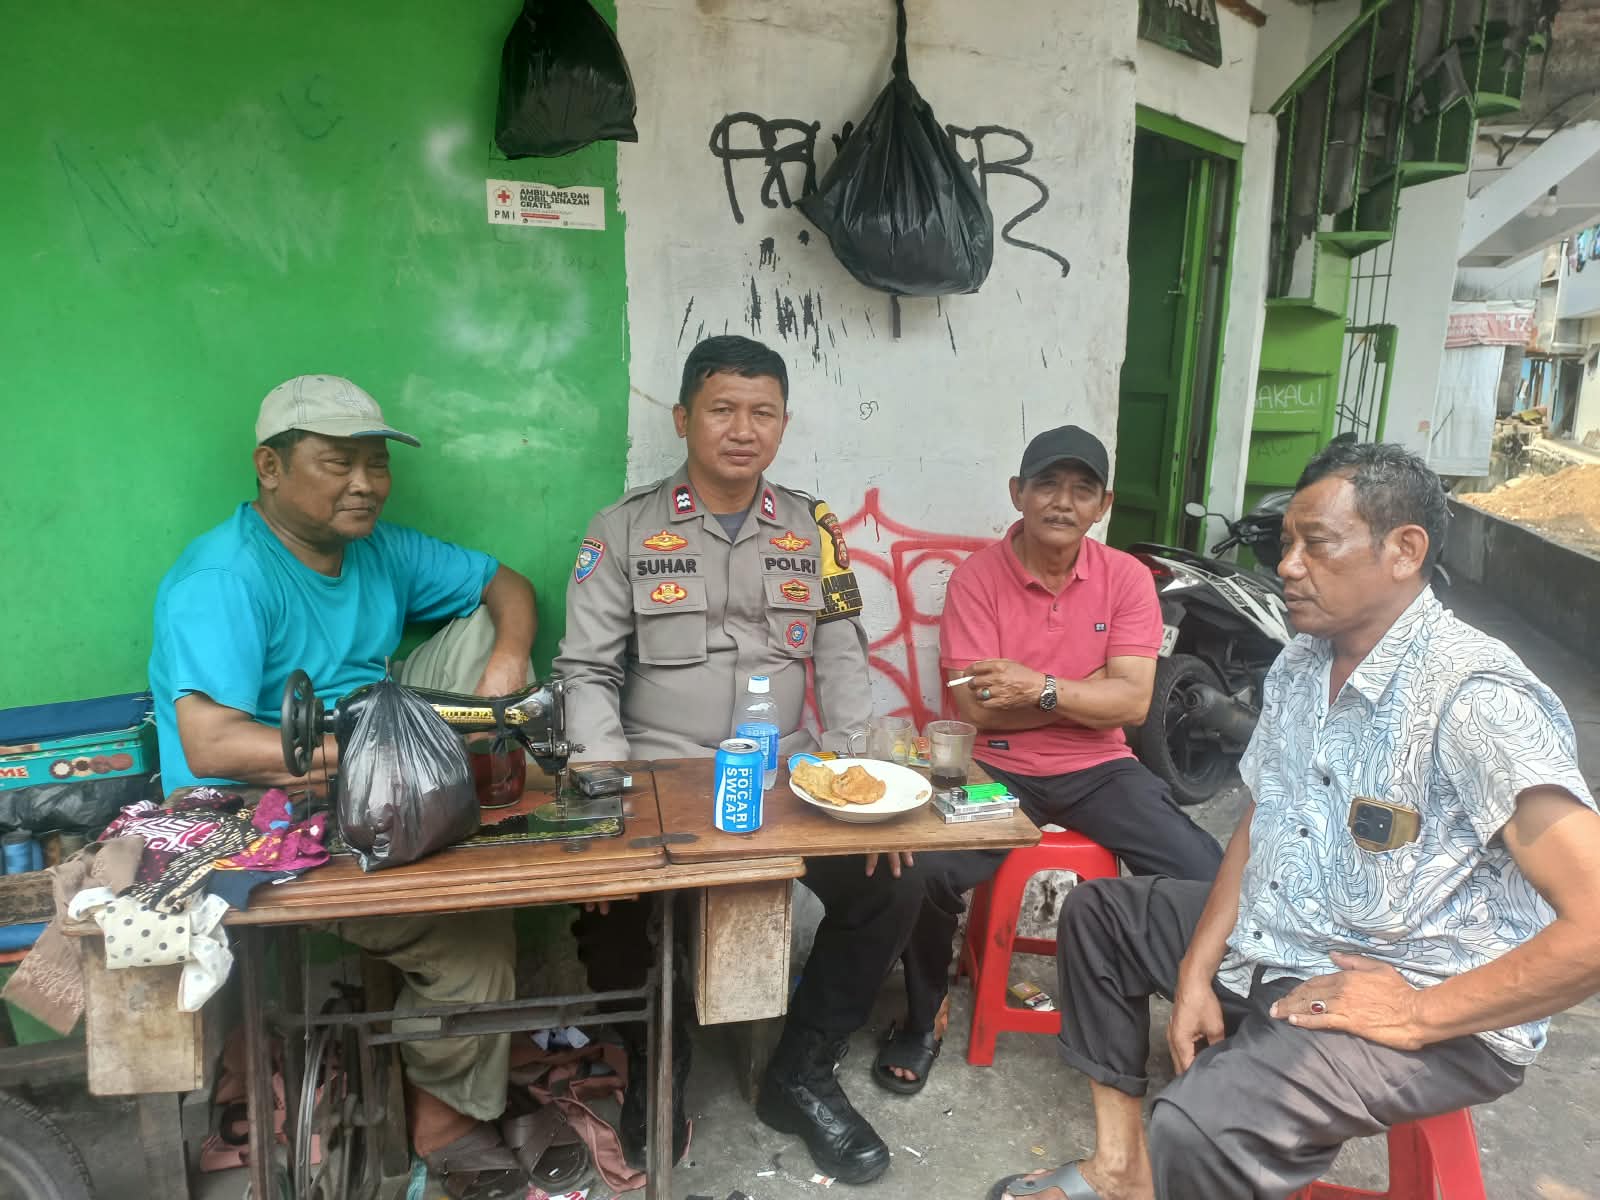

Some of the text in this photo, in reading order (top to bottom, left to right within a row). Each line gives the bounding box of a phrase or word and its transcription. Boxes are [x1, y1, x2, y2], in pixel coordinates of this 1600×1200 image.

[520, 188, 590, 200] AMBULANS DAN
[520, 194, 590, 206] MOBIL JENAZAH
[520, 201, 552, 209] GRATIS
[636, 558, 697, 576] SUHAR
[764, 557, 816, 574] POLRI
[725, 767, 737, 823] SWEAT
[736, 767, 749, 829] POCARI
